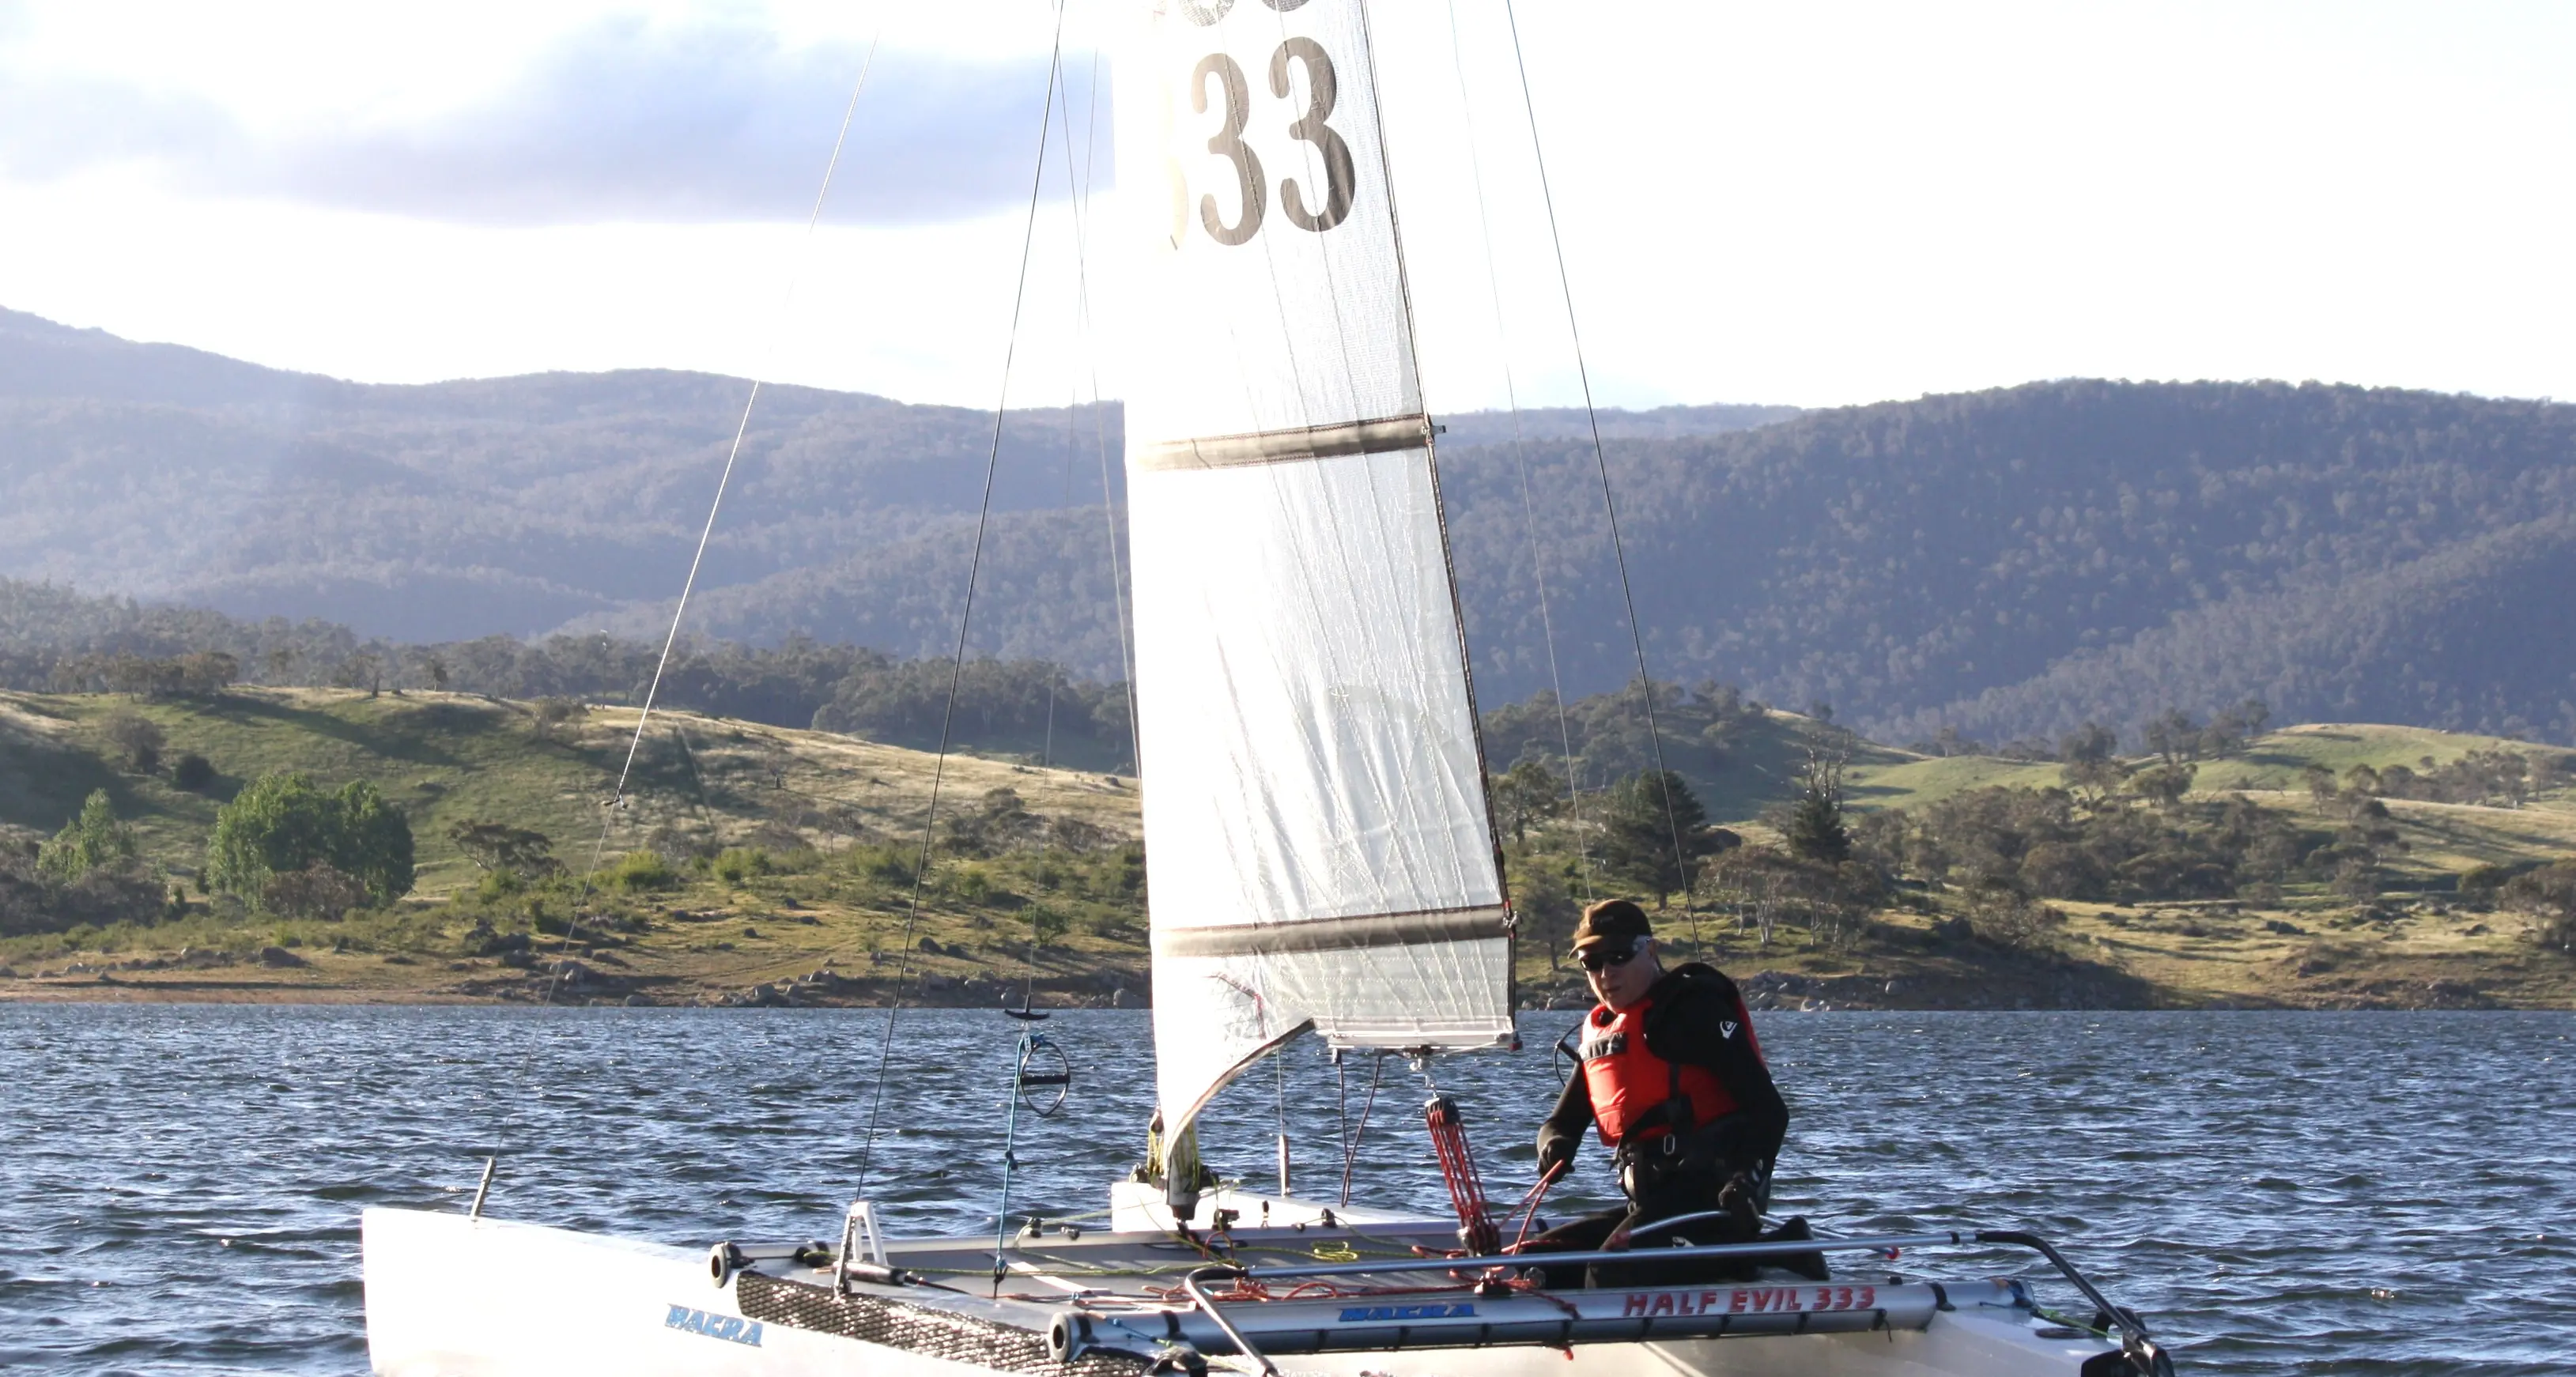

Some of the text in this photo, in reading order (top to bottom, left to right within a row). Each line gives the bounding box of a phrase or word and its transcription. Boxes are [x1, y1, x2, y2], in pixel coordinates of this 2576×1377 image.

[1623, 1286, 1875, 1316] HALF EVIL 333
